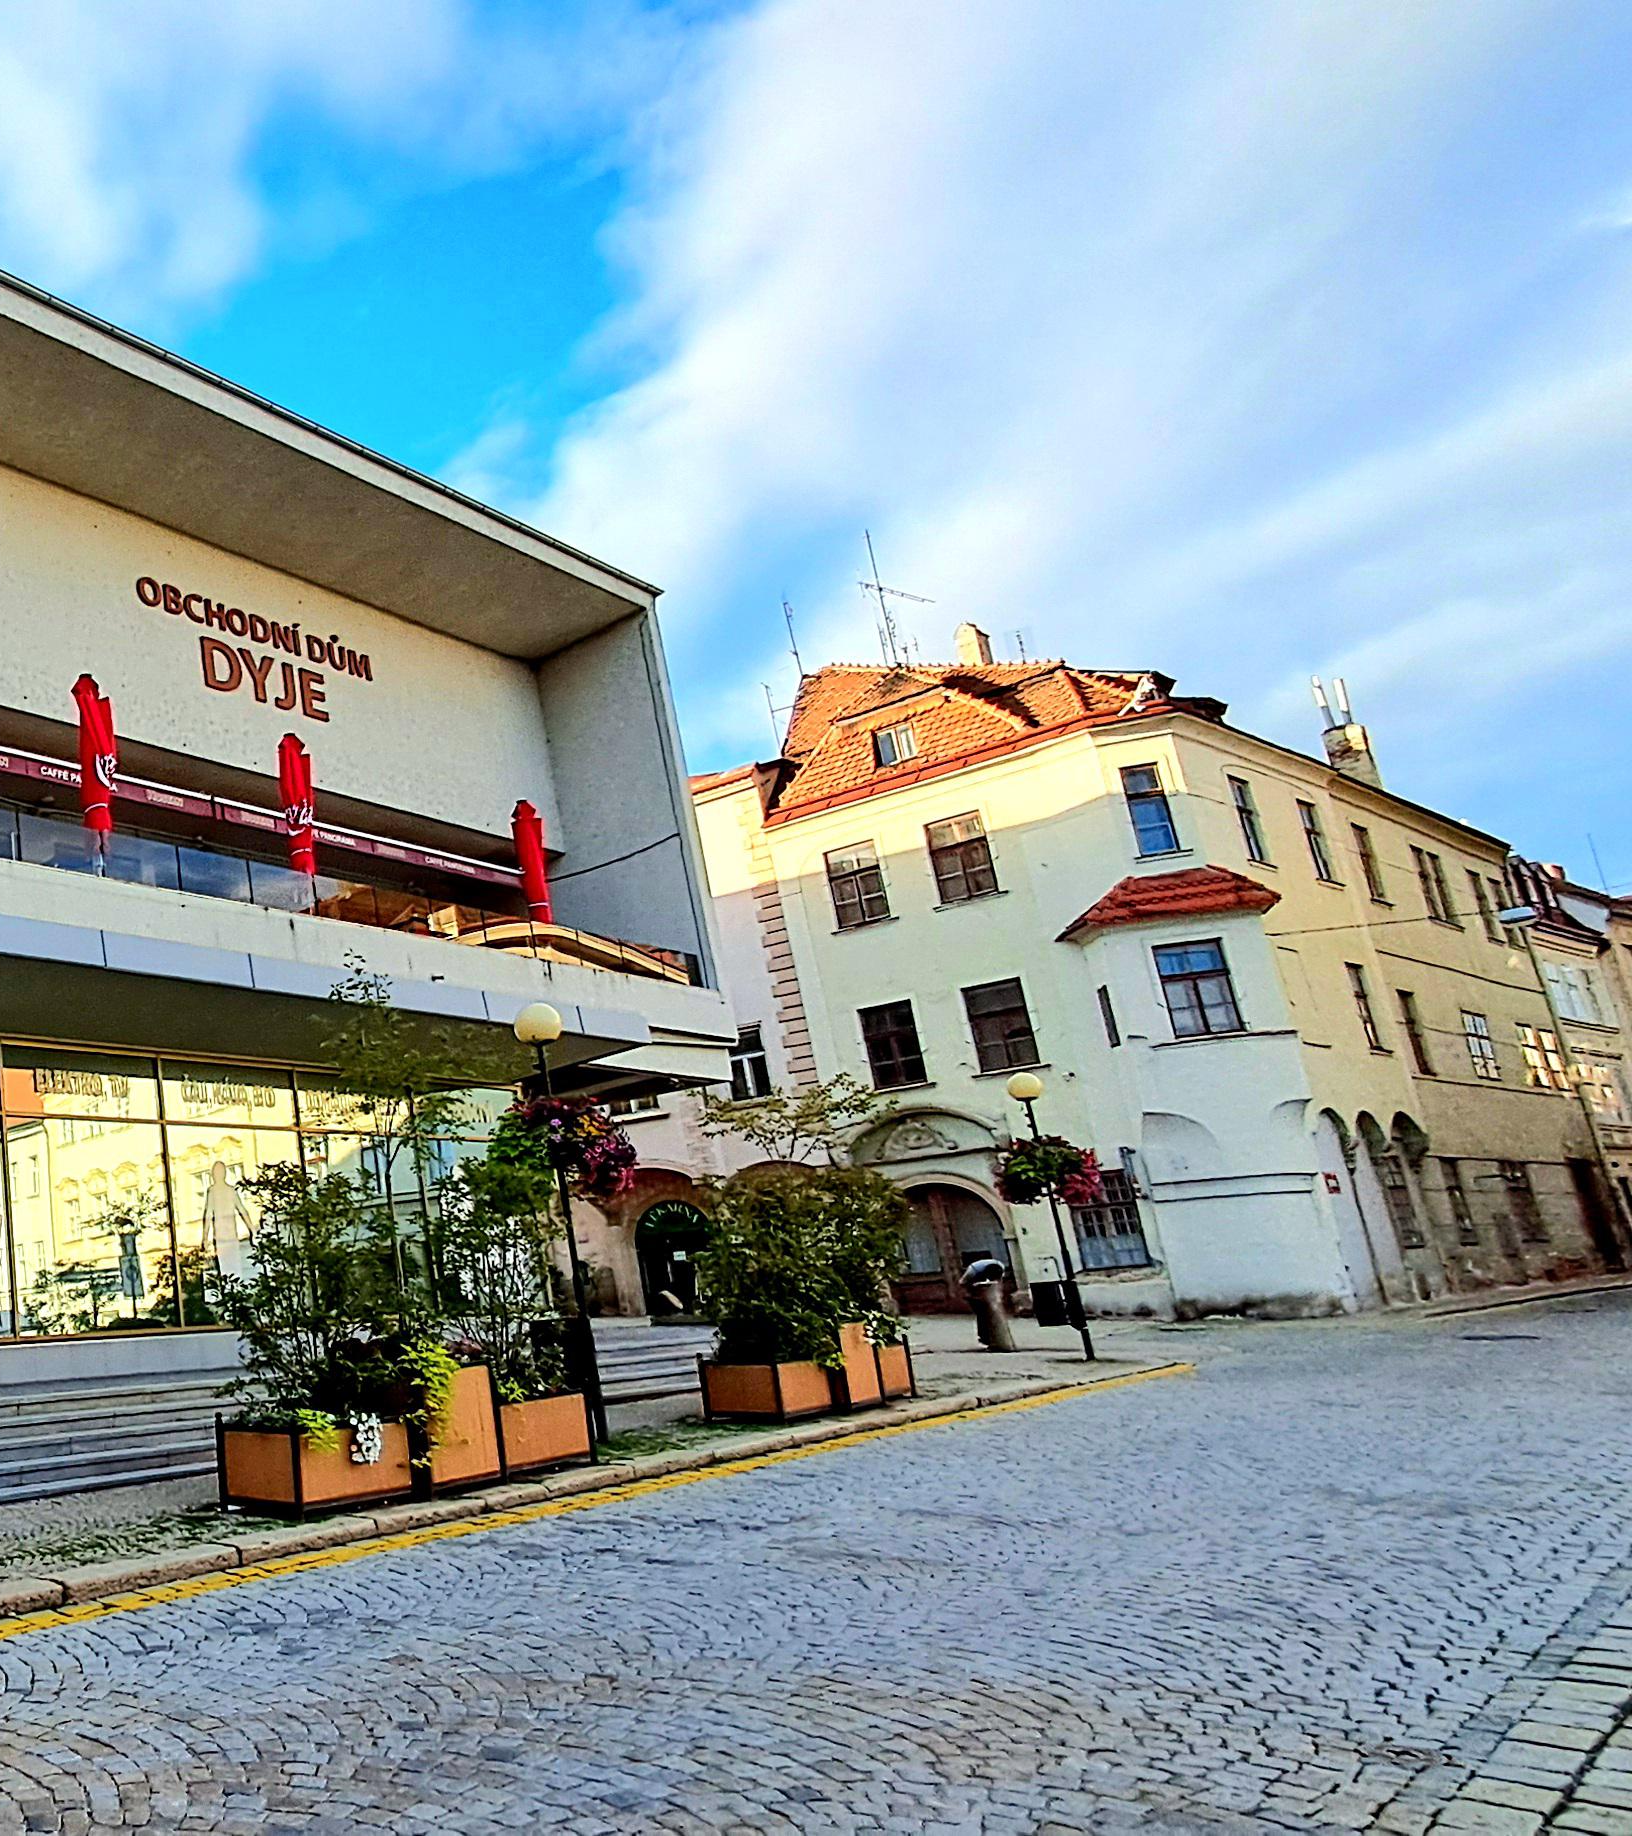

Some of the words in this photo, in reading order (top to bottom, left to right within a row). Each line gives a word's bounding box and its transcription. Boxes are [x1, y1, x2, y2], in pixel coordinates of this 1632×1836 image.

[135, 576, 302, 656] OBCHODNÍ
[305, 634, 373, 682] DŮM
[199, 635, 330, 722] DYJE
